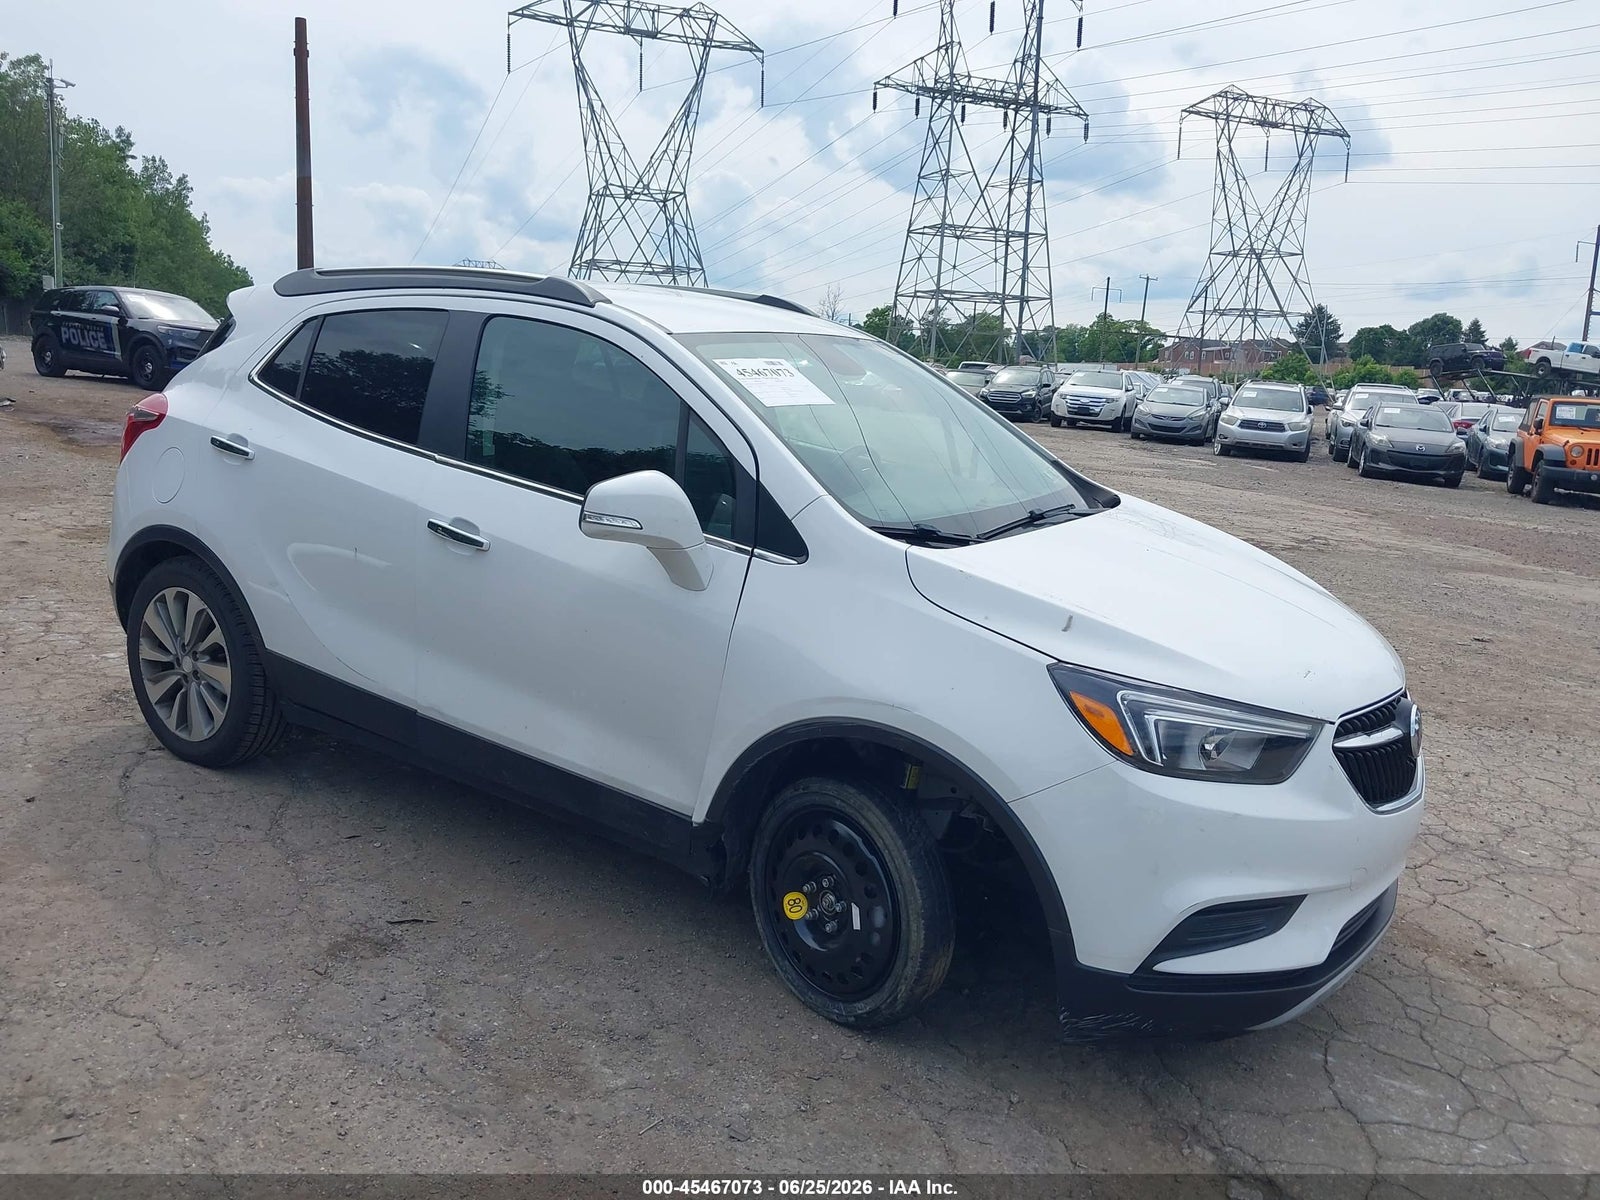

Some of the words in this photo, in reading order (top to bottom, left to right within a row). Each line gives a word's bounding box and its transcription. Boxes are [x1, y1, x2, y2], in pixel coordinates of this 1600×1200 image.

[61, 327, 108, 349] POLICE
[736, 368, 795, 378] 45467073
[788, 898, 802, 913] 80
